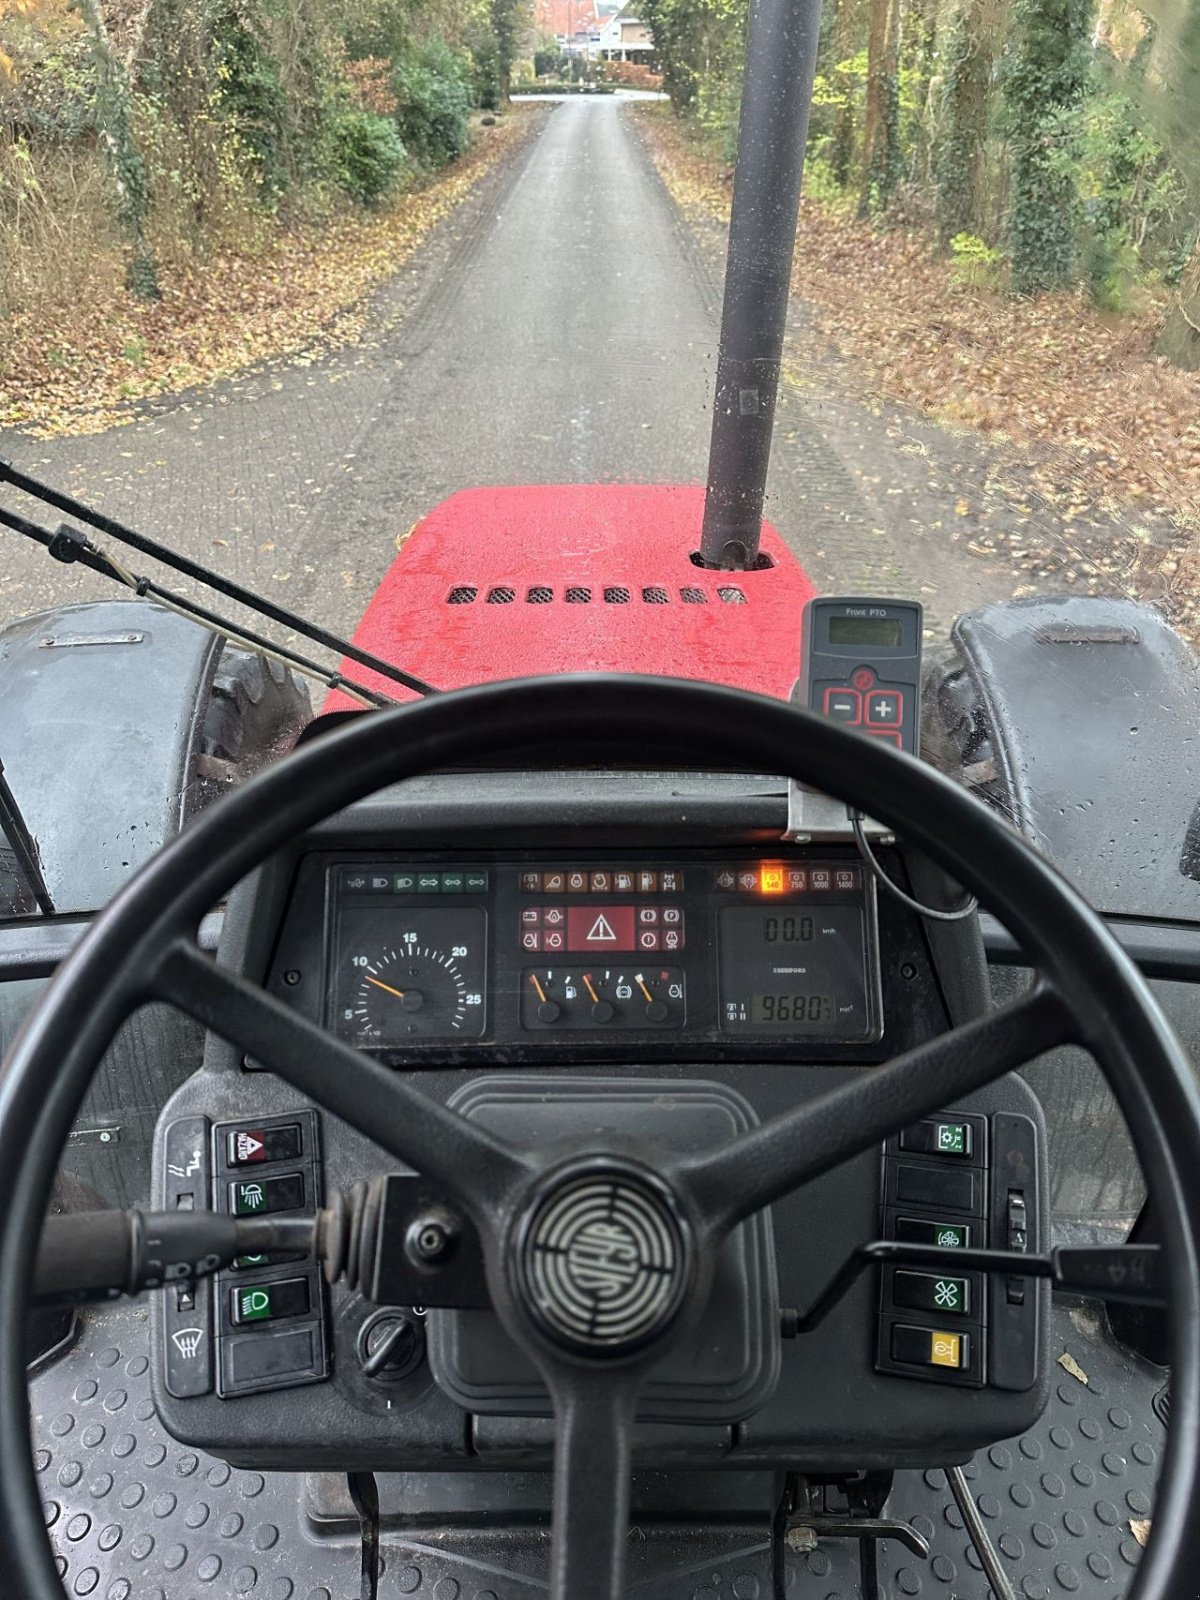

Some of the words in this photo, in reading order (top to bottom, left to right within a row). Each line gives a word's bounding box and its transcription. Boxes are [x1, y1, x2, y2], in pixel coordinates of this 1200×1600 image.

[846, 607, 866, 616] Front
[869, 608, 887, 617] PTO
[766, 881, 779, 889] 540
[813, 881, 829, 889] 1000
[403, 933, 417, 943] 15
[451, 946, 467, 957] 20
[352, 956, 368, 966] 10
[466, 994, 481, 1004] 25
[344, 1009, 353, 1019] 5
[568, 1222, 639, 1298] STEYR
